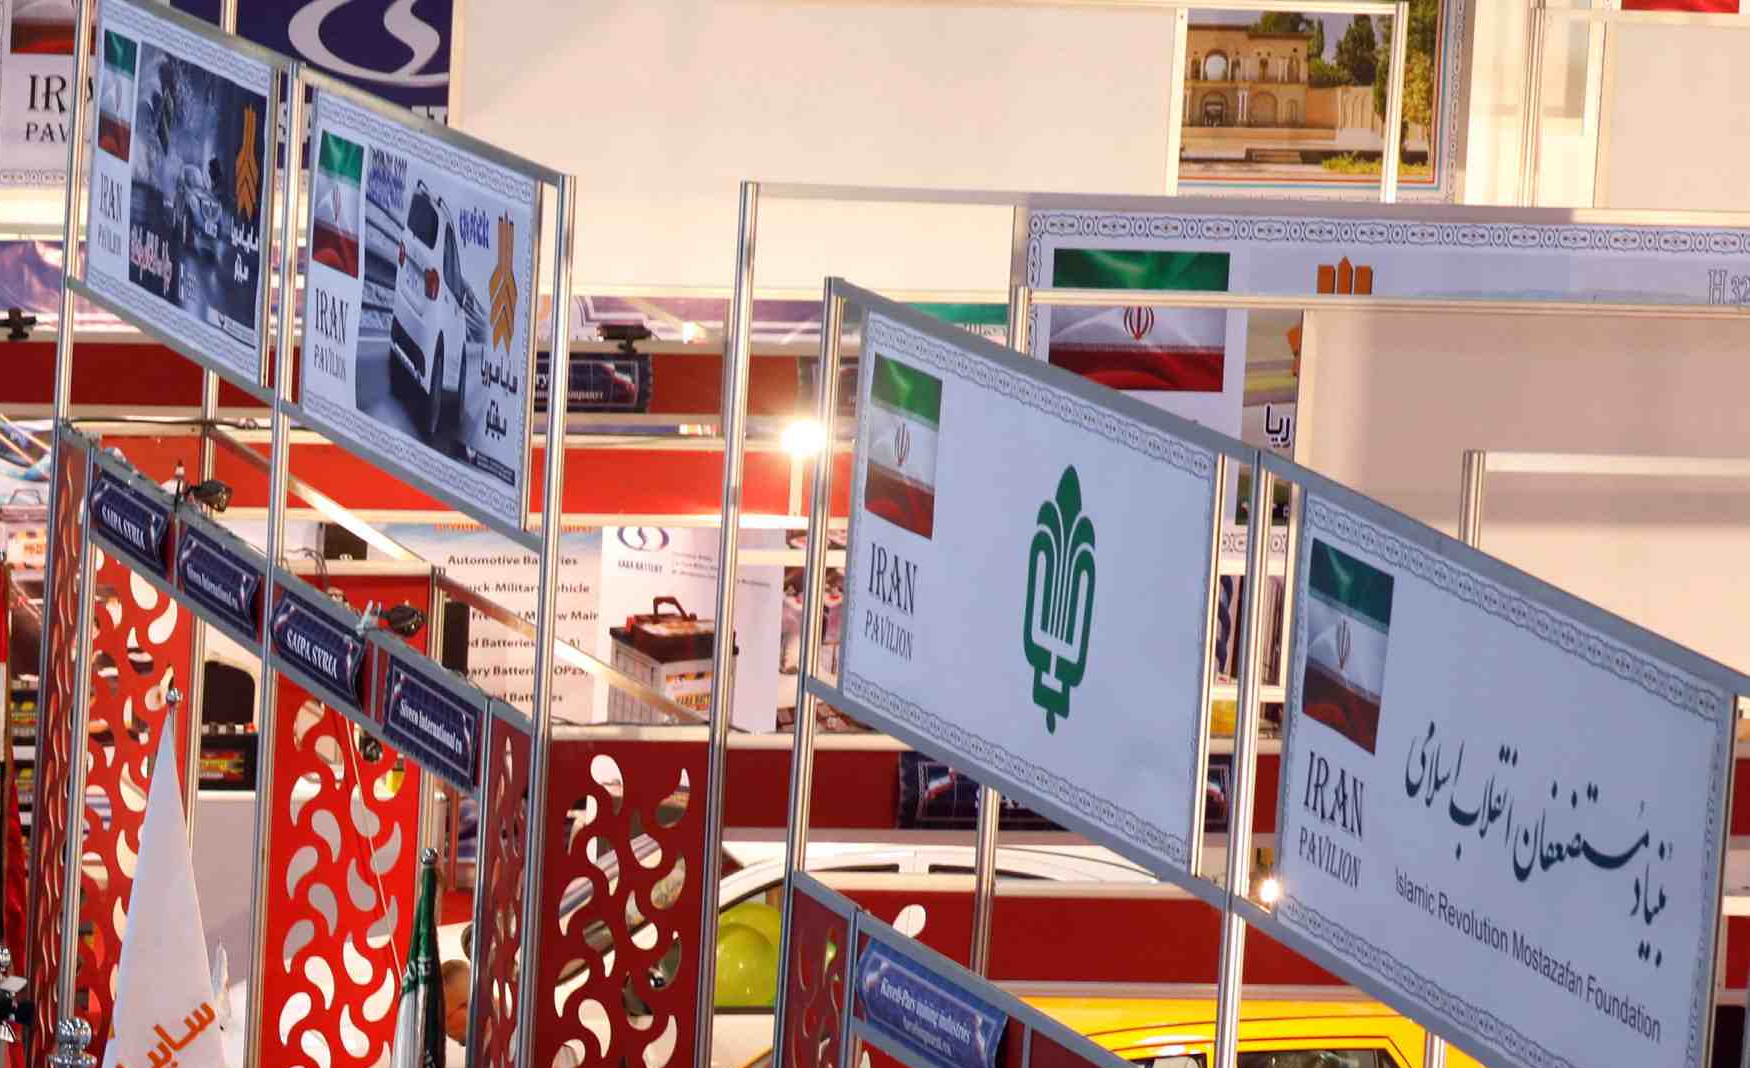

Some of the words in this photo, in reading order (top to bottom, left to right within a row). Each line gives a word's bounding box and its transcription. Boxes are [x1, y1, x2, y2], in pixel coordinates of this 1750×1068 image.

[315, 288, 348, 344] IRAN
[101, 504, 123, 534] SAIPA
[123, 519, 145, 550] SYRIA
[447, 555, 520, 566] Automotive
[523, 555, 578, 566] Baies
[868, 542, 917, 616] IRAN
[556, 584, 590, 593] ehicle
[286, 628, 311, 661] SAIPA
[312, 645, 337, 679] SYRIA
[864, 609, 912, 662] PAVILION
[1303, 751, 1364, 841] IRAN
[1298, 826, 1361, 888] PAVILION
[1395, 867, 1435, 916] Islamic
[1438, 891, 1508, 954] Revolution
[1512, 930, 1583, 1001] Mostazafan
[1586, 975, 1661, 1043] Foundation
